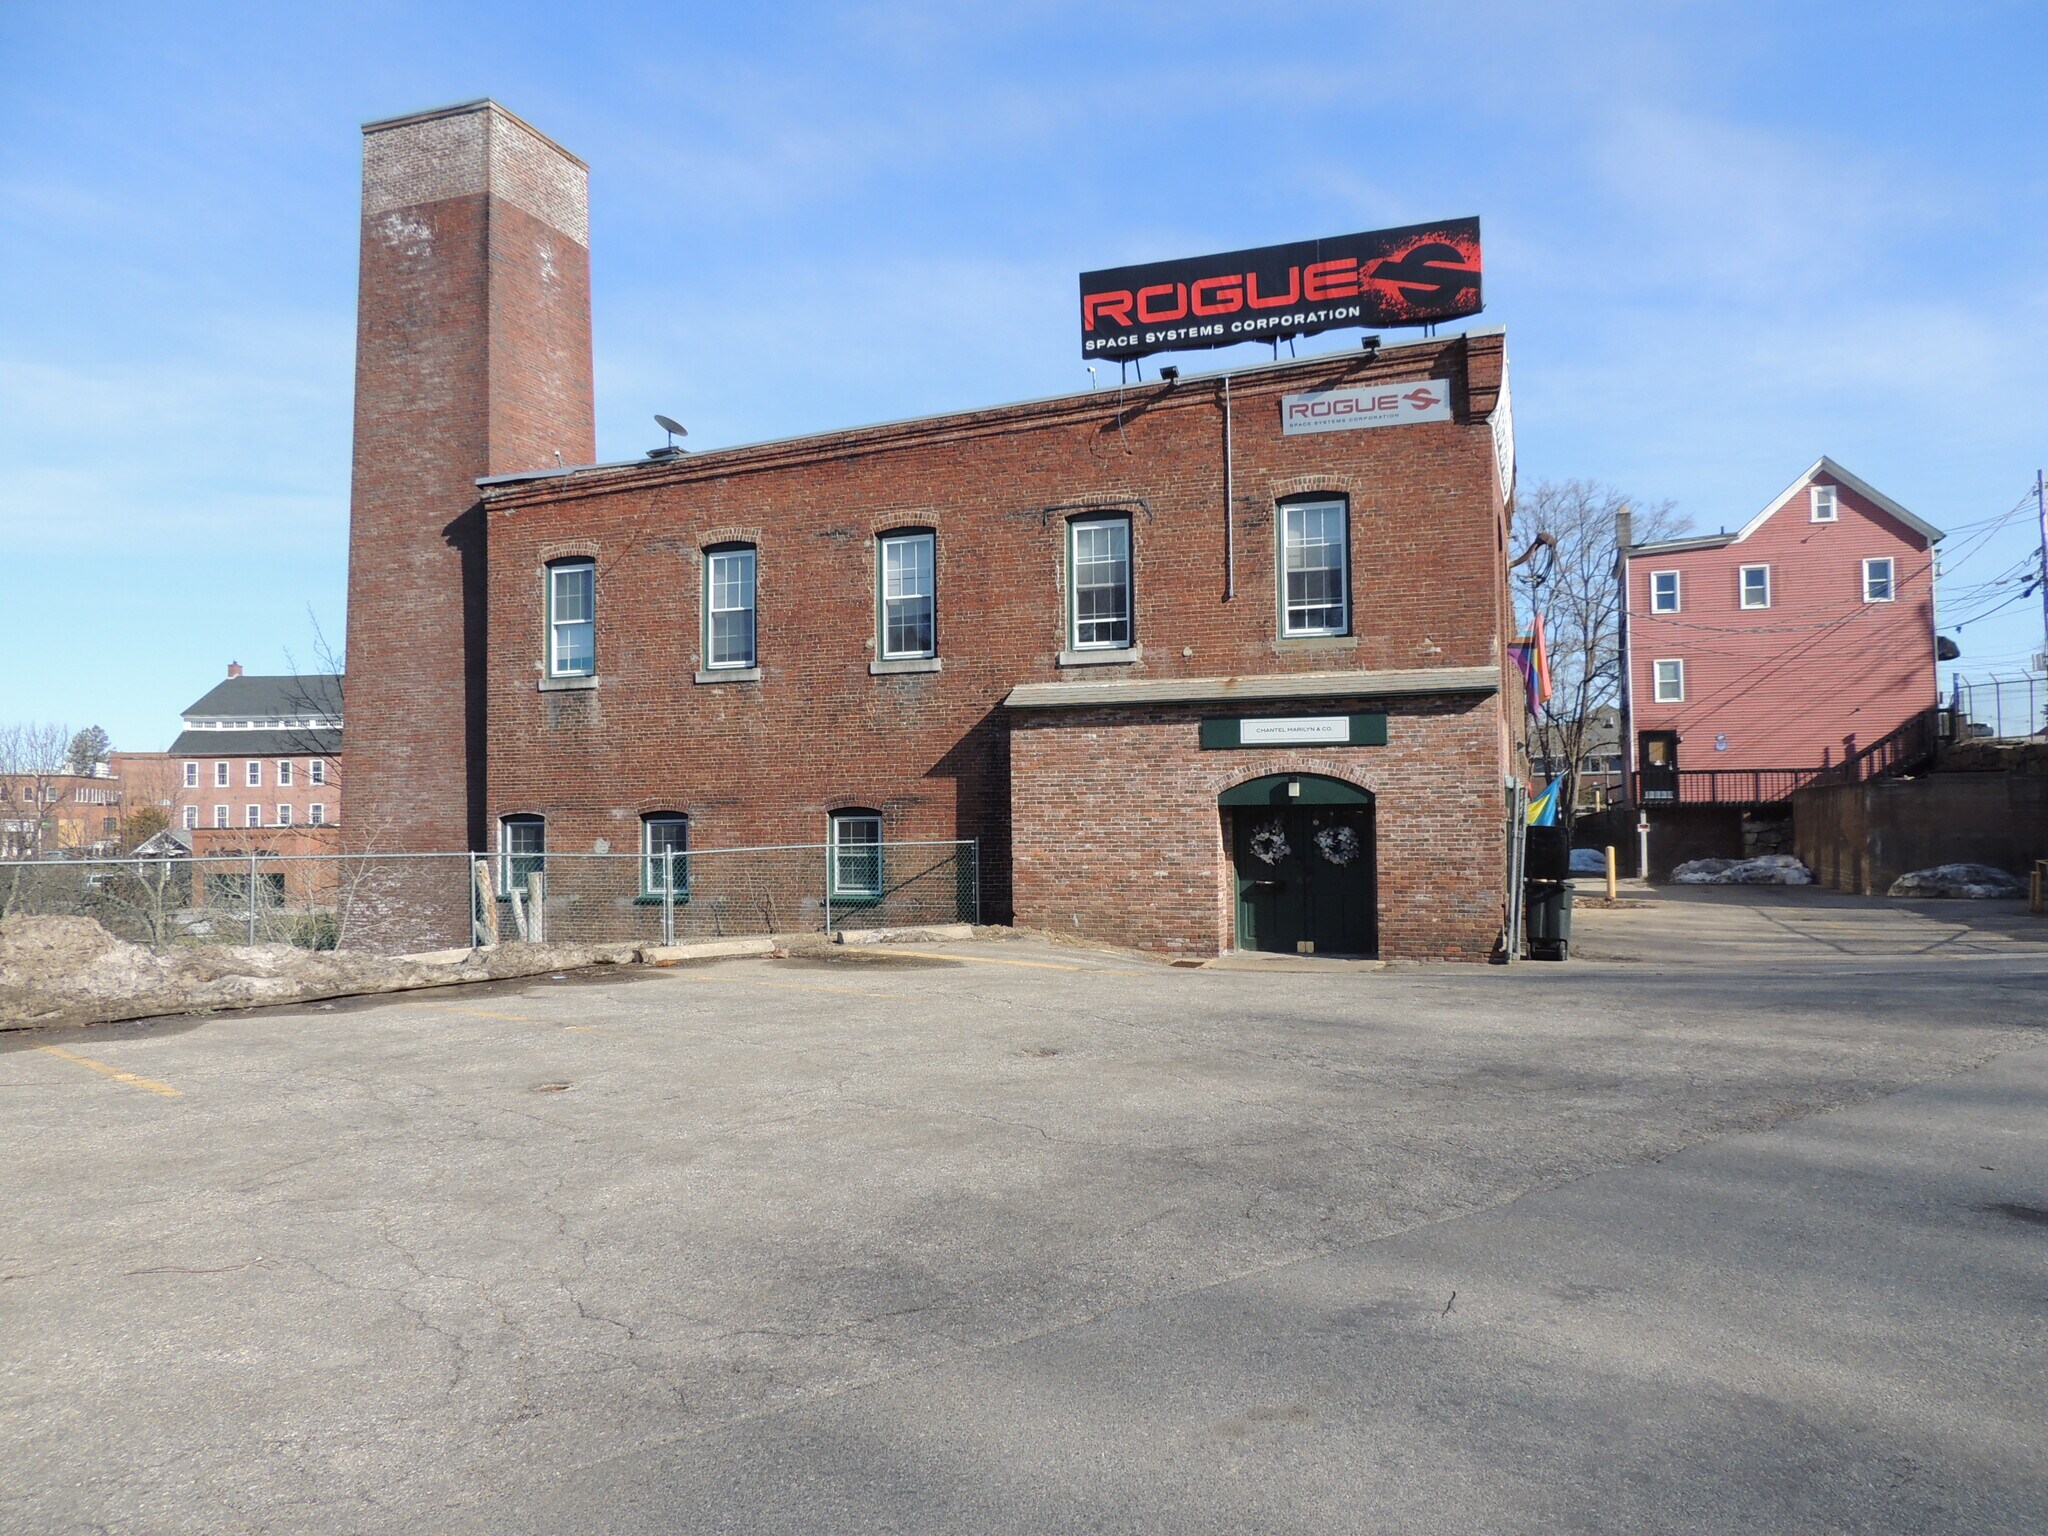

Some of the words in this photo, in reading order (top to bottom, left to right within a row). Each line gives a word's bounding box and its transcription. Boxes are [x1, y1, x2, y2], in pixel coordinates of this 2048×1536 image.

[1084, 257, 1358, 332] ROGUE
[1085, 335, 1139, 350] SPACE
[1145, 324, 1225, 343] SYSTEMS
[1231, 306, 1360, 332] CORPORATION
[1289, 395, 1399, 419] ROGUE
[1314, 418, 1346, 426] SYSTEMS
[1348, 413, 1400, 423] CORPORATION
